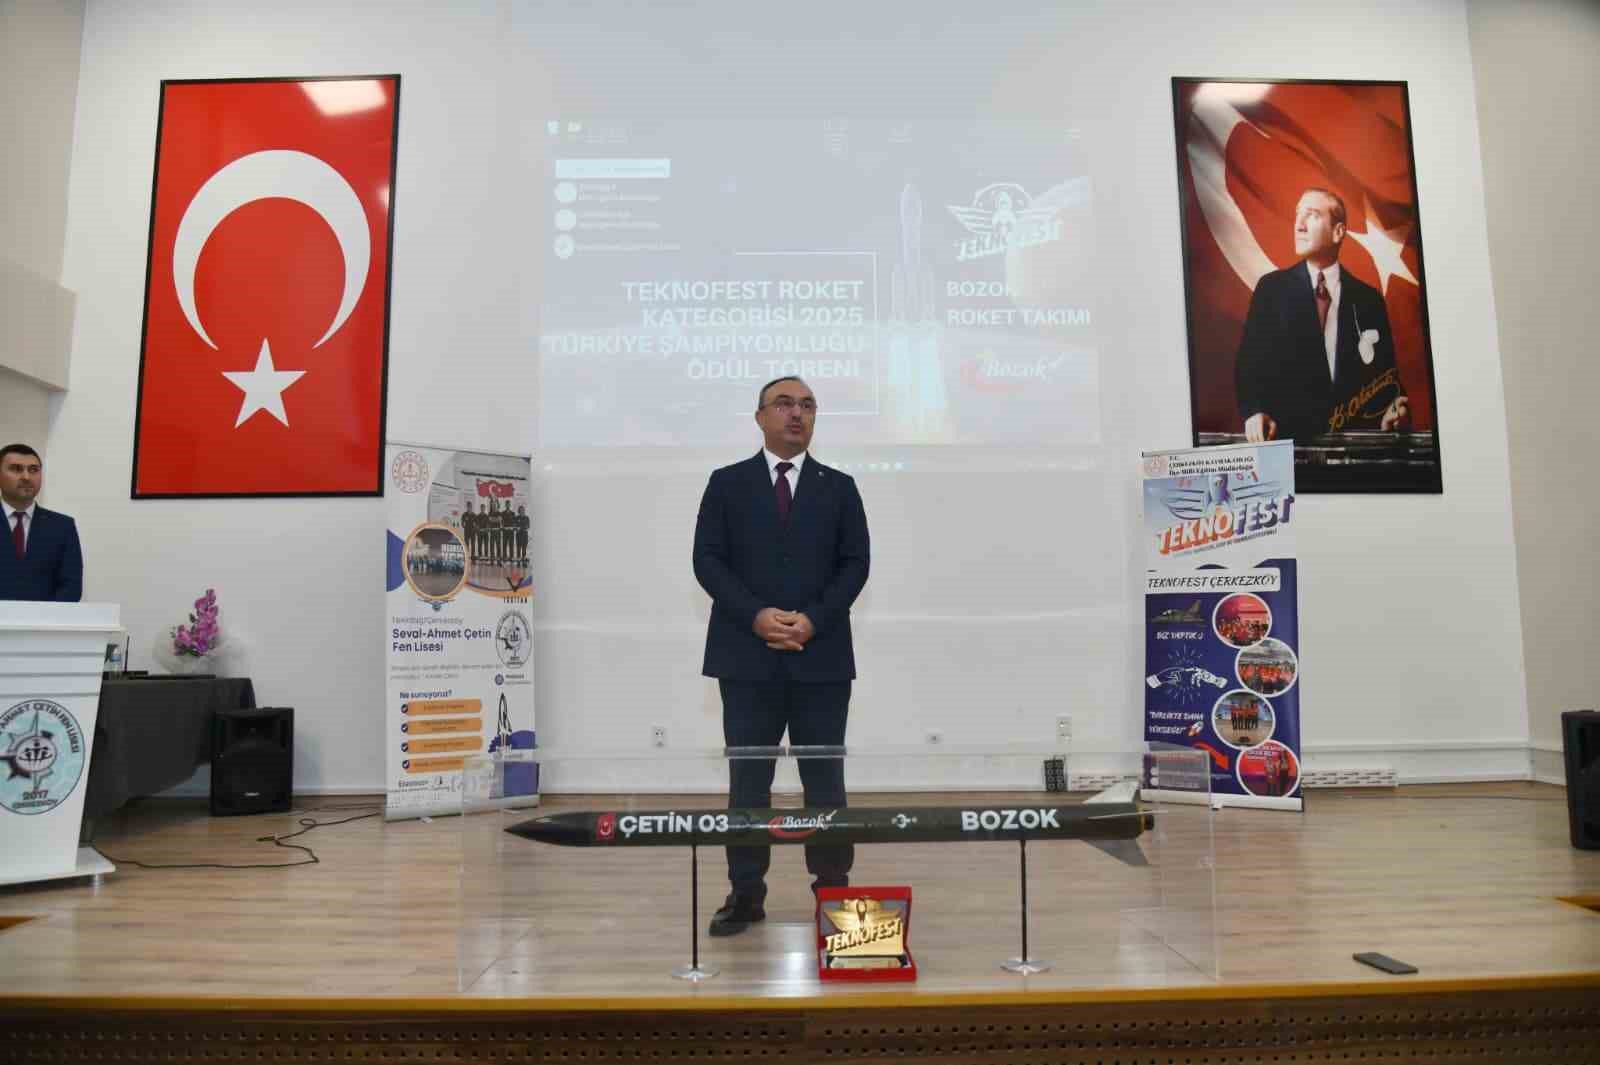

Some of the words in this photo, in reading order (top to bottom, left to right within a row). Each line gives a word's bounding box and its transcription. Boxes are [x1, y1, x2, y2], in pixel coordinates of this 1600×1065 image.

[622, 281, 771, 301] TEKNOFEST
[778, 279, 864, 300] ROKET
[642, 304, 794, 328] KATEGORİSİ
[802, 305, 864, 327] 2025
[945, 308, 1016, 325] ROKET
[1021, 308, 1091, 325] TAKIMI
[547, 332, 652, 354] TÜRKİYE
[659, 332, 864, 358] ŞAMPİYONLUĞU
[686, 355, 761, 380] ÖDÜL
[1158, 493, 1295, 555] TEKNOFEST
[1148, 577, 1210, 588] TEKNOFEST
[392, 628, 462, 639] Seval-Ahmet
[464, 628, 492, 640] Çetin
[392, 642, 412, 652] Fen
[414, 642, 444, 652] Lisesi
[22, 790, 49, 801] 2017
[619, 811, 693, 837] ÇETİN
[699, 814, 729, 833] 03
[960, 808, 1060, 831] BOZOK
[825, 918, 902, 953] TEKNOFEST
